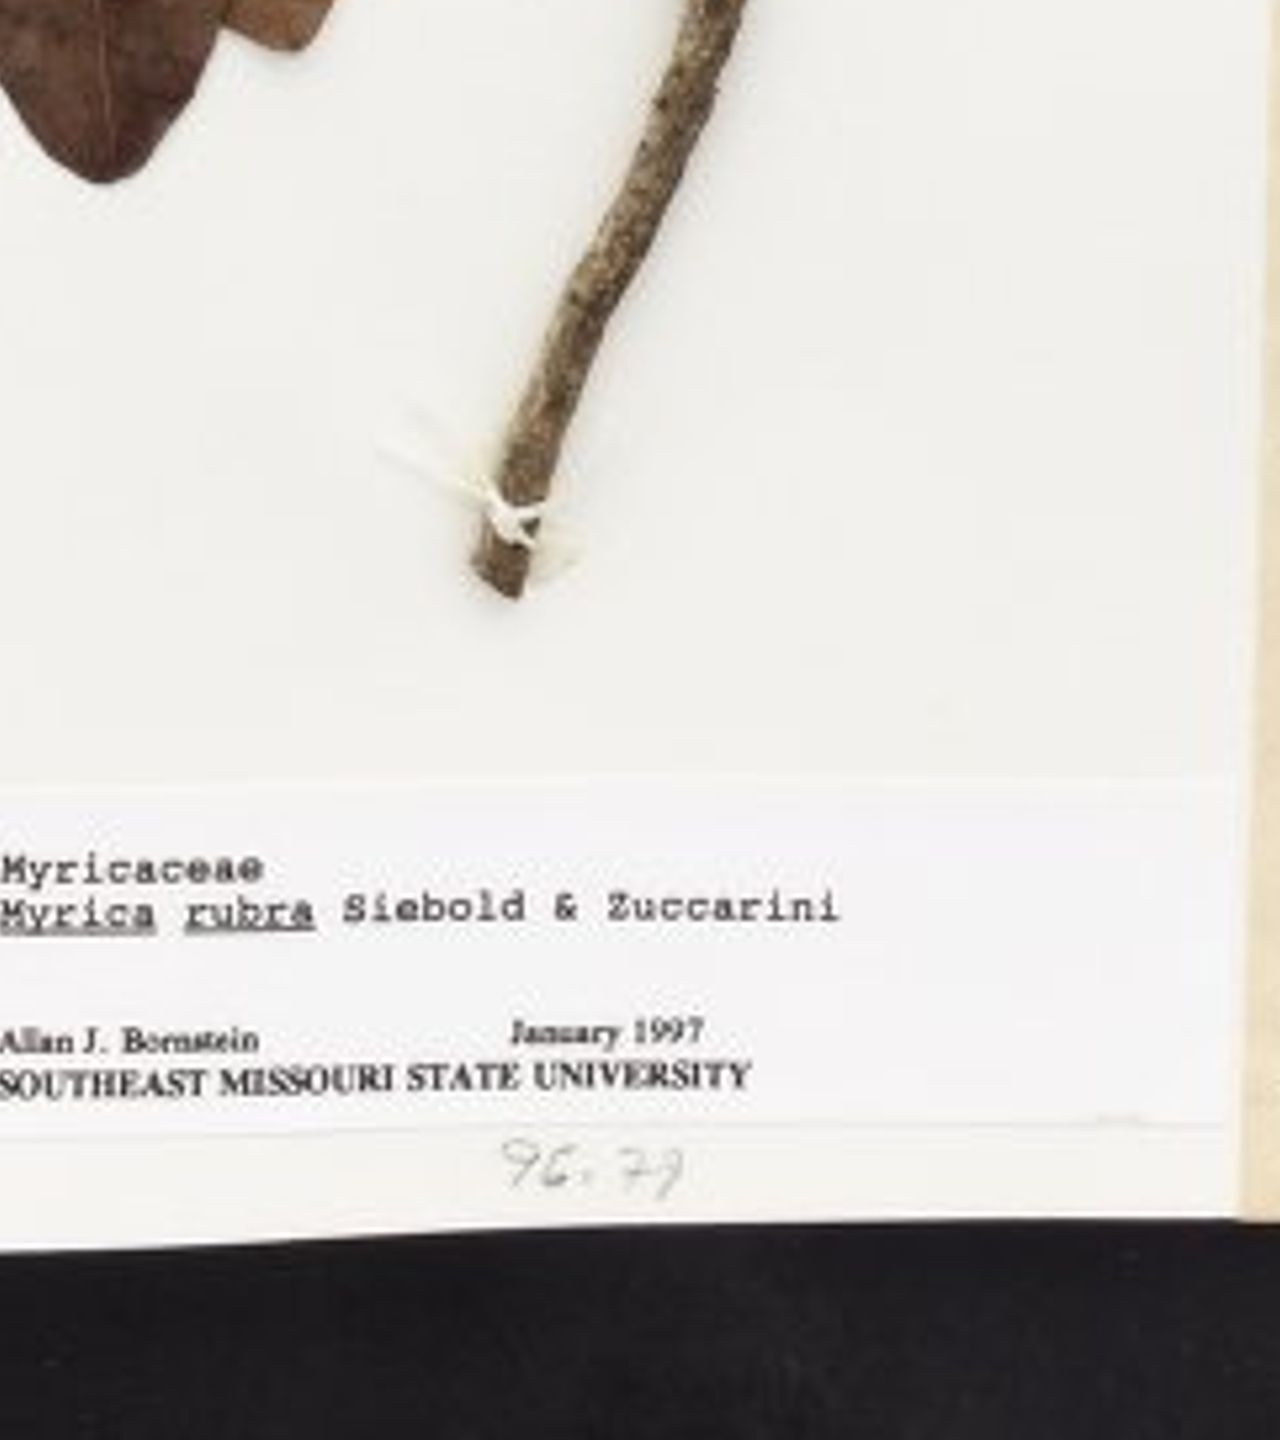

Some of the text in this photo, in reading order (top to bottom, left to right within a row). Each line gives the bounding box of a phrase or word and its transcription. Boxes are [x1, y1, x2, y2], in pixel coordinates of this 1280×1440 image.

[2, 852, 266, 891] Myricaceae
[0, 888, 840, 934] Myrica rubra Siebold & Zuccarini
[82, 1026, 108, 1056] J.
[120, 1025, 260, 1055] Bornstein
[510, 1018, 623, 1052] January
[633, 1016, 705, 1045] 1997
[218, 1063, 395, 1099] MISSOURI
[405, 1062, 522, 1092] STATE
[532, 1060, 753, 1091] UNIVERSITY
